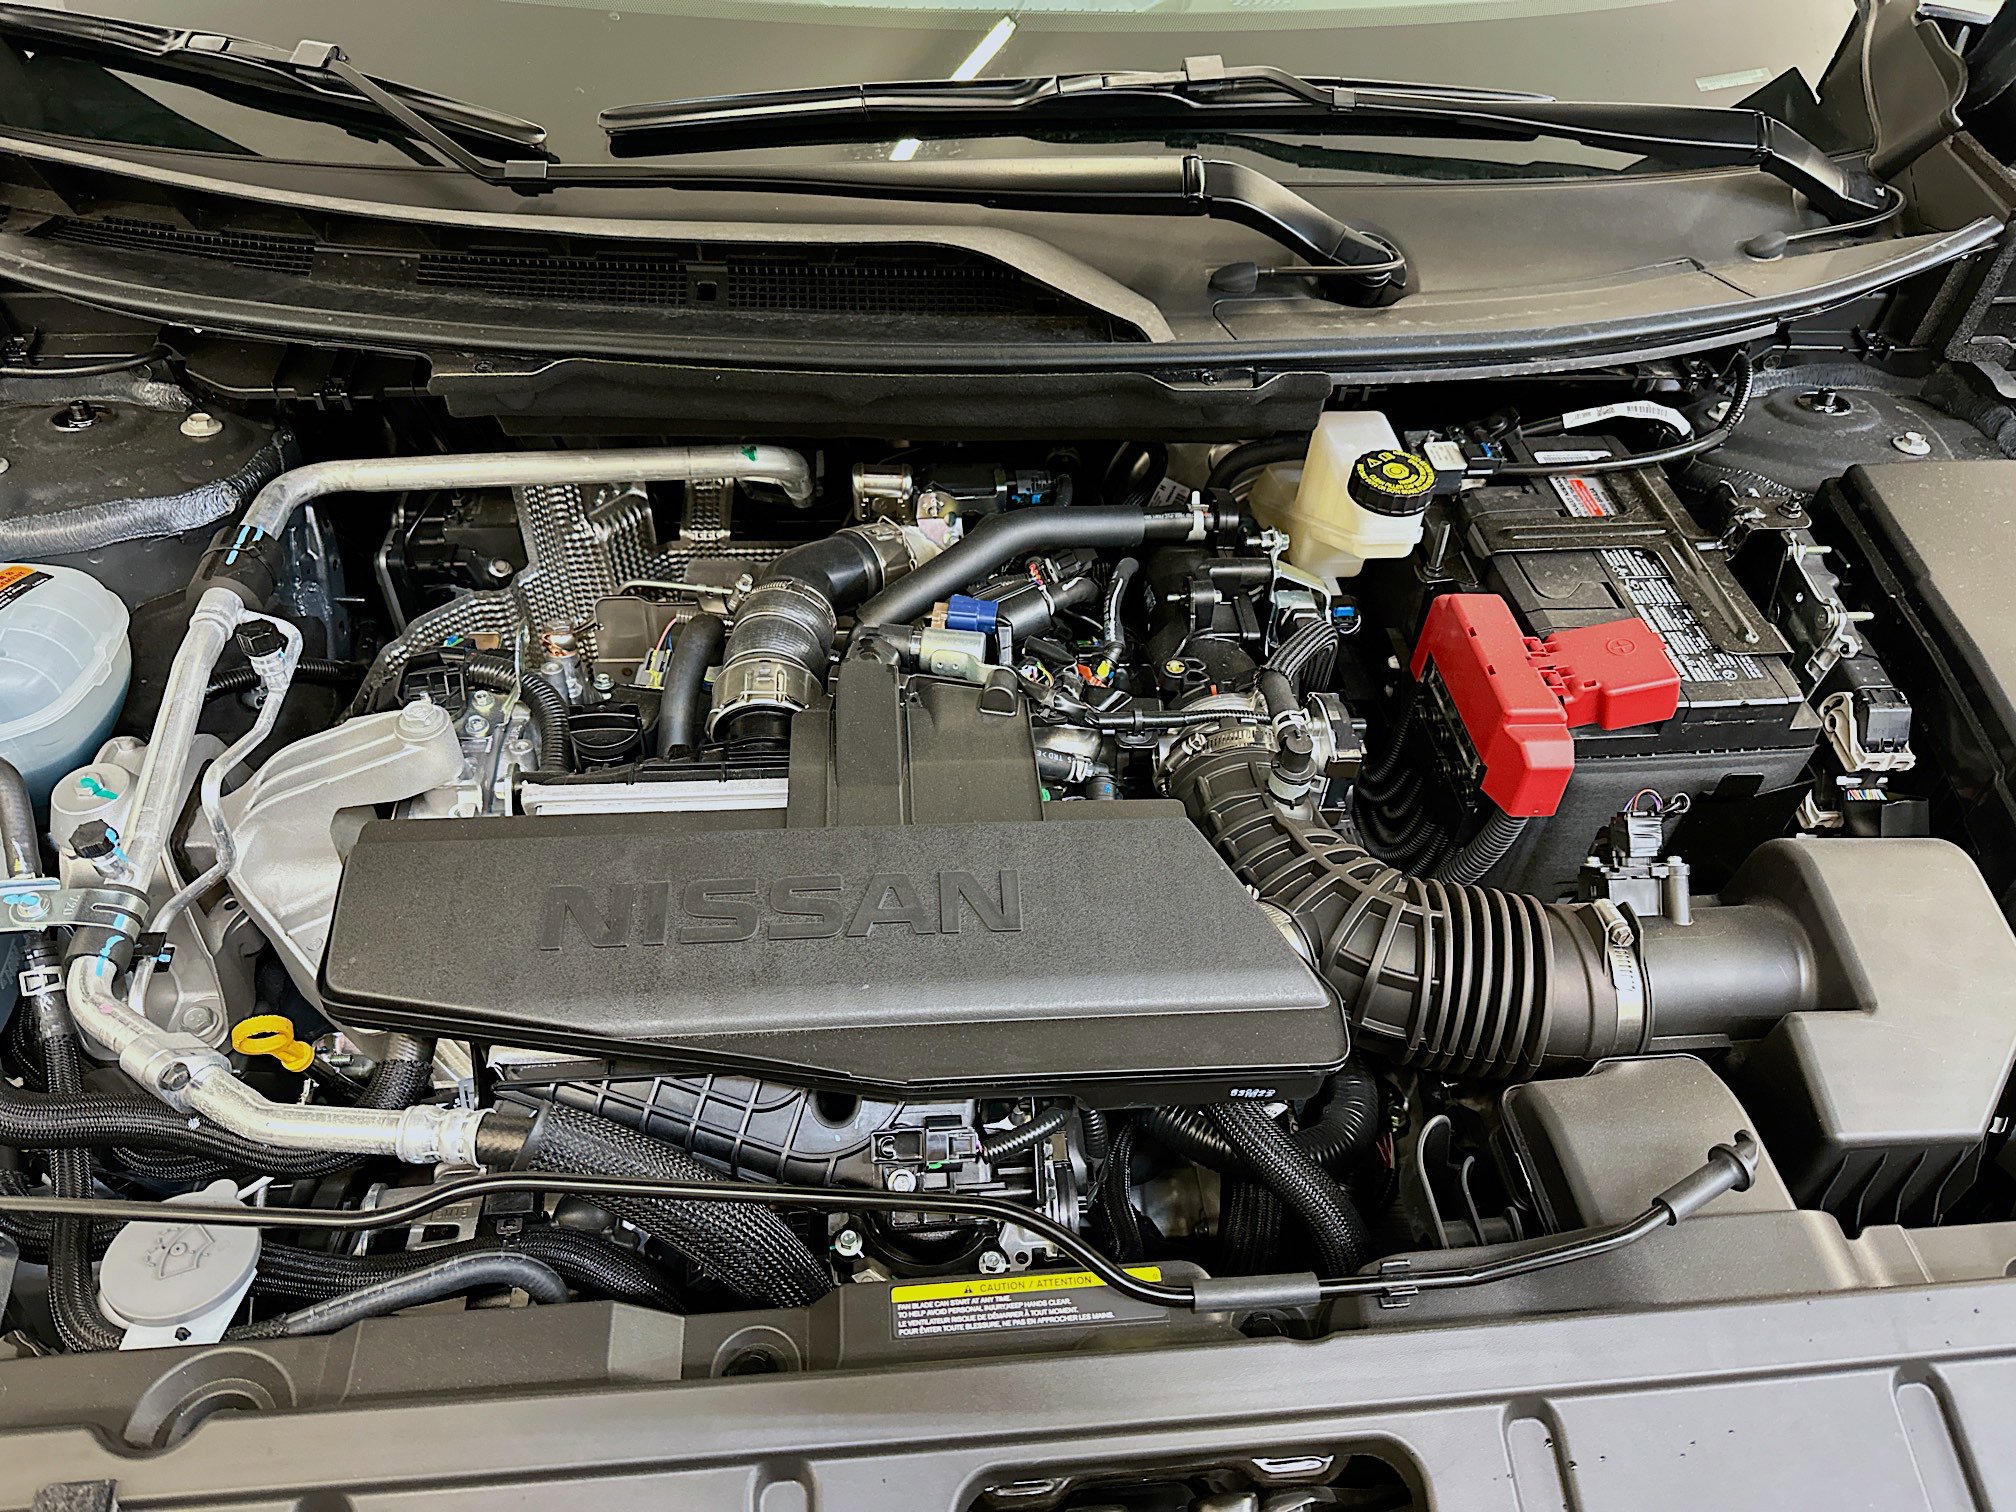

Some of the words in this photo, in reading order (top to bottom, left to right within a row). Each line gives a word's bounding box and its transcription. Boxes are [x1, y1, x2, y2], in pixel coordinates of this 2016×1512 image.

[540, 869, 1023, 950] NISSAN
[980, 1282, 1025, 1293] CAUTION
[1037, 1277, 1092, 1288] ATTENTION
[927, 1308, 947, 1316] AVOID
[948, 1306, 983, 1314] PERSONAL
[1024, 1300, 1047, 1308] HANDS
[1048, 1298, 1072, 1306] CLEAR.
[950, 1298, 970, 1306] START
[898, 1328, 919, 1336] POUR
[919, 1325, 942, 1334] ÉVITER
[943, 1324, 965, 1332] TOUTE
[1037, 1315, 1078, 1324] APPROCHER
[908, 1317, 950, 1326] VENTILATEUR
[951, 1315, 976, 1323] RISQUE
[987, 1311, 1023, 1320] DÉMARRER
[1049, 1307, 1078, 1315] MOMENT.
